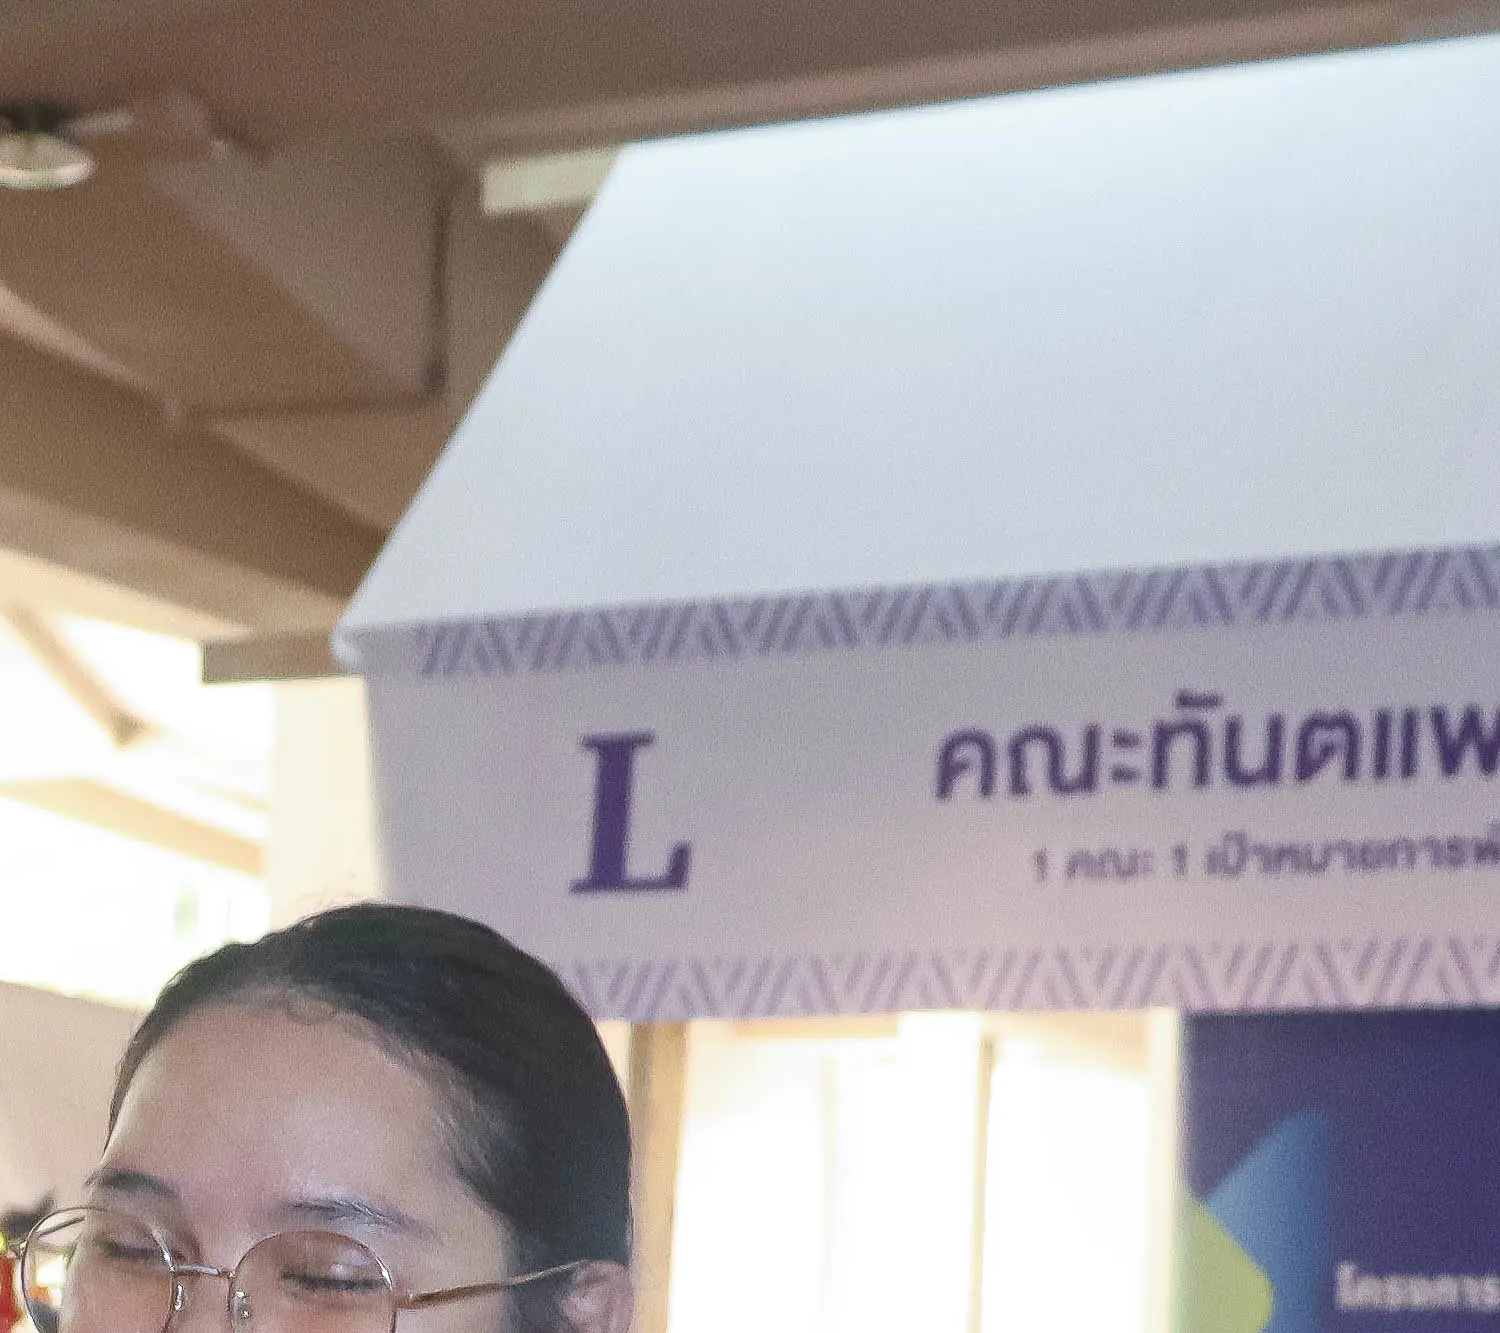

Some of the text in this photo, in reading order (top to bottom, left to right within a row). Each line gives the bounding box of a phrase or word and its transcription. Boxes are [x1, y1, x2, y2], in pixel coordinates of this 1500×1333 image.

[568, 730, 691, 894] L
[1034, 848, 1048, 881] 1
[1172, 843, 1188, 877] 1
